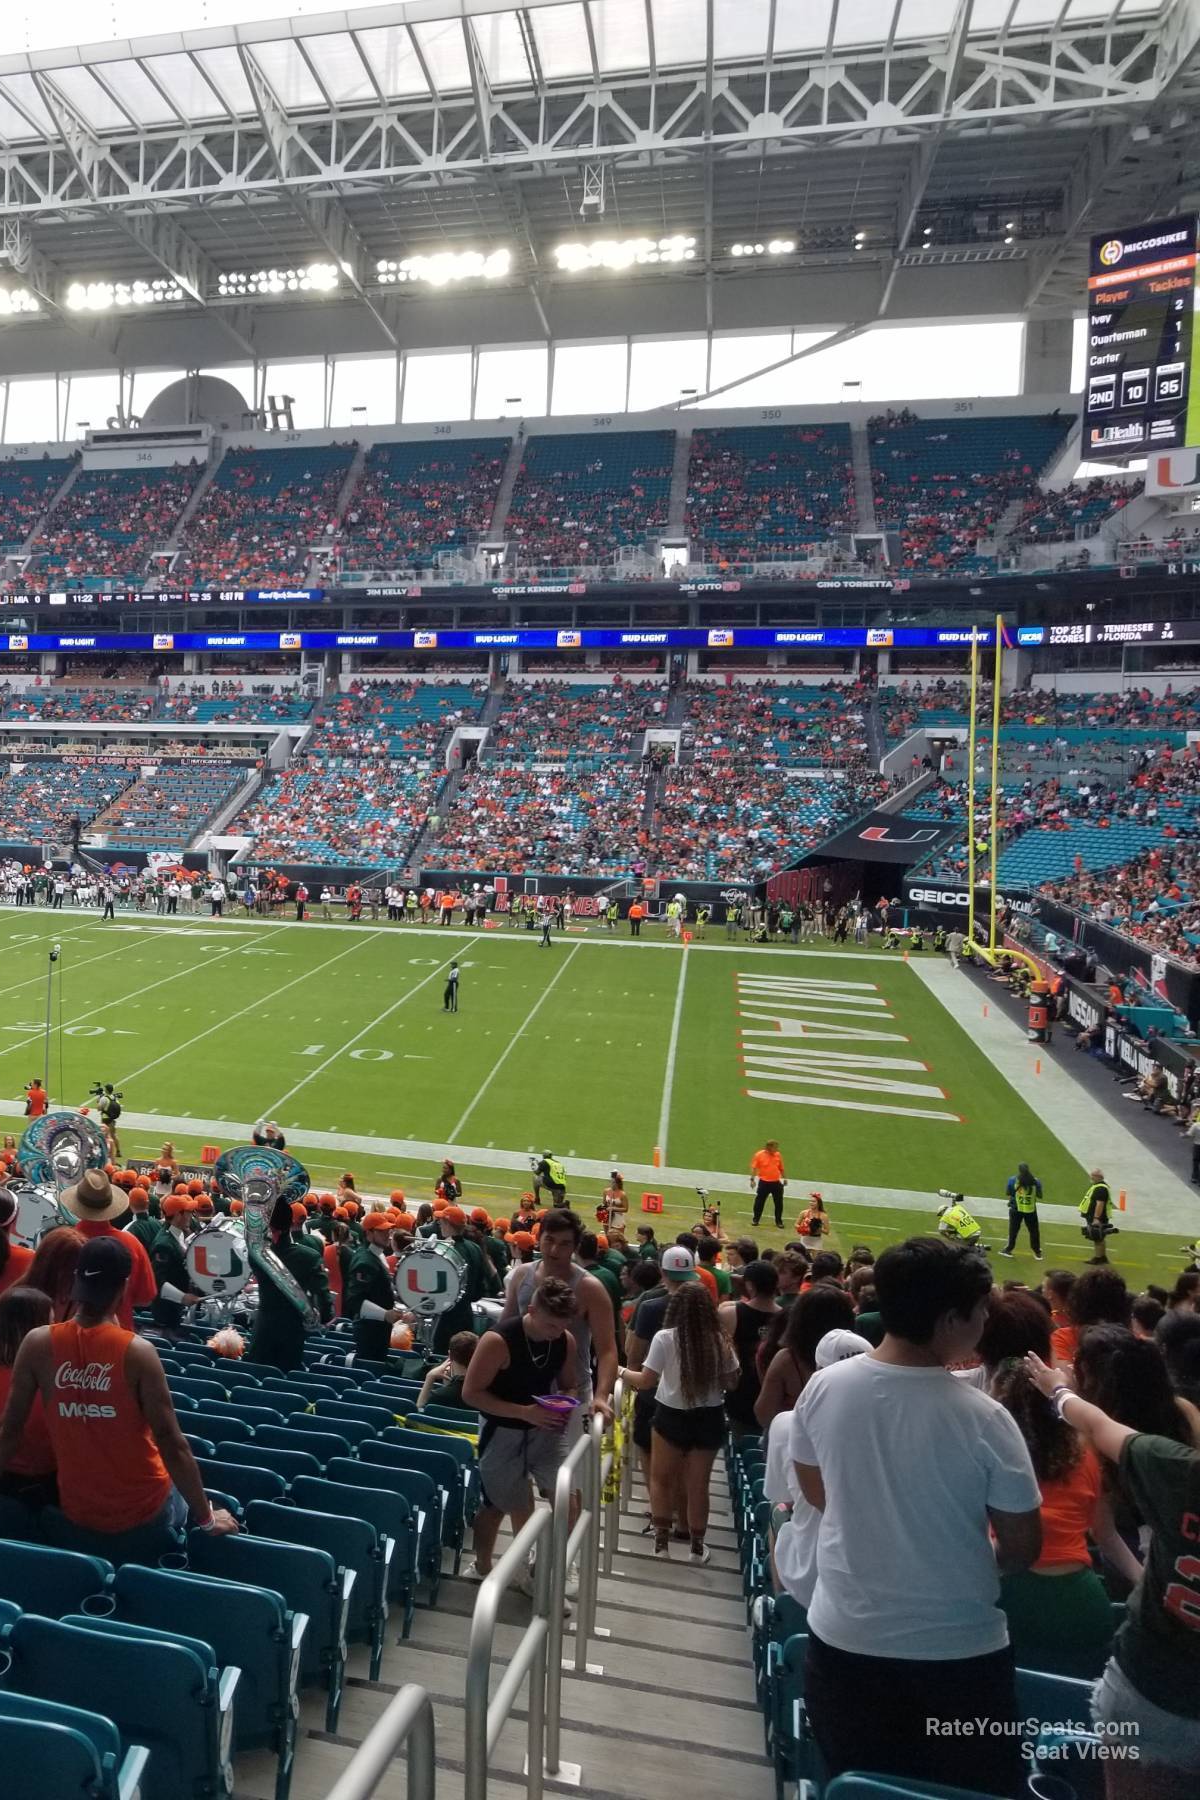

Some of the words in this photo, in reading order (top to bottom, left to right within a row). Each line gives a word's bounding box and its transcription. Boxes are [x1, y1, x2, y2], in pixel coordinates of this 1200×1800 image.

[1124, 231, 1188, 254] MICCOSUKEE
[1149, 276, 1191, 294] Tackles
[1096, 290, 1129, 304] Player
[1091, 313, 1112, 326] Ivey
[1175, 300, 1184, 310] 2
[1091, 328, 1147, 347] Quarterman
[1176, 321, 1182, 331] 1
[1090, 352, 1120, 366] Carter
[1175, 342, 1180, 352] 1
[1159, 380, 1179, 394] 35
[1090, 391, 1113, 404] 2ND
[1127, 386, 1142, 399] 10
[954, 403, 973, 412] 351
[762, 410, 781, 419] 350
[593, 418, 612, 426] 349
[434, 426, 451, 434] 348
[285, 434, 301, 442] 347
[136, 453, 152, 461] 346
[1168, 563, 1200, 575] RIN
[492, 586, 526, 594] CORTEZ
[527, 585, 568, 593] KENNEDY
[679, 583, 695, 591] JIM
[697, 583, 722, 591] OTTO
[816, 581, 841, 589] GINO
[843, 580, 893, 589] TORRETTA
[366, 588, 380, 596] JIM
[382, 588, 407, 596] KELLY
[14, 596, 29, 604] MIA
[34, 596, 41, 604] 0
[73, 594, 93, 603] 11:22
[159, 594, 168, 602] 10
[201, 593, 212, 601] 35
[1051, 626, 1069, 634] TOP
[1070, 625, 1082, 634] 25
[1104, 623, 1154, 633] TENNESSEE
[208, 637, 223, 645] BUD
[224, 637, 245, 645] LIGHT
[354, 636, 378, 644] LIGHT
[475, 635, 493, 643] BUD
[493, 635, 517, 643] LIGHT
[622, 634, 640, 642] BUD
[641, 634, 667, 642] LIGHT
[797, 633, 824, 641] LIGHT
[939, 633, 959, 641] BUD
[1050, 634, 1084, 643] SCORES
[1104, 632, 1142, 641] FLORIDA
[1161, 631, 1174, 640] 34
[60, 638, 74, 646] BUD
[75, 638, 95, 646] LIGHT
[97, 757, 125, 765] CANES
[127, 758, 162, 766] SOCIETY
[909, 888, 970, 906] GEICO
[1069, 990, 1099, 1029] NISSAN
[290, 1044, 394, 1060] 10
[183, 1170, 208, 1181] YOUR
[647, 1195, 659, 1211] G
[194, 1246, 243, 1277] U
[407, 1269, 447, 1294] U
[59, 1402, 117, 1419] MOSS
